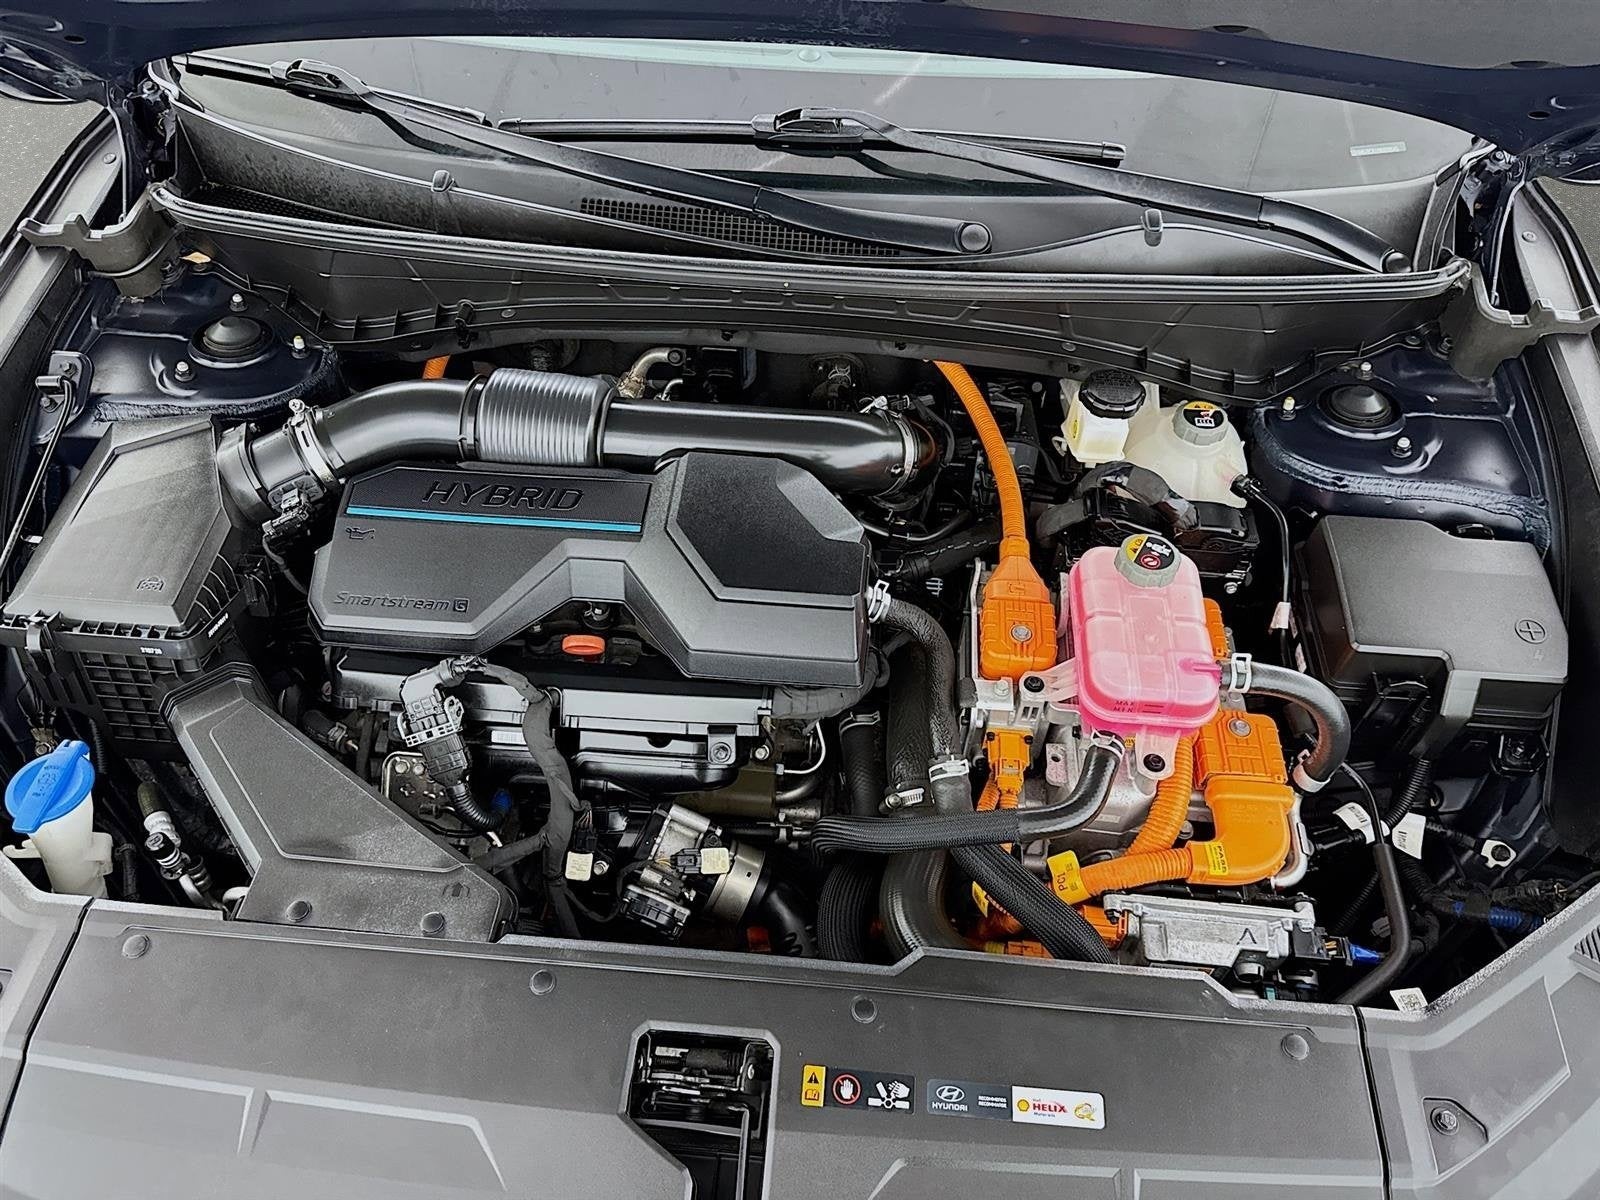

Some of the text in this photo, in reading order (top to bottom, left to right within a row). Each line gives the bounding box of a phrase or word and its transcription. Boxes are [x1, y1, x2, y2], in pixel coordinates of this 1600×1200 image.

[422, 480, 584, 511] HYBRID
[333, 590, 450, 611] Smartstream
[931, 1101, 968, 1112] HYUNDAI
[1032, 1103, 1068, 1114] HELIX
